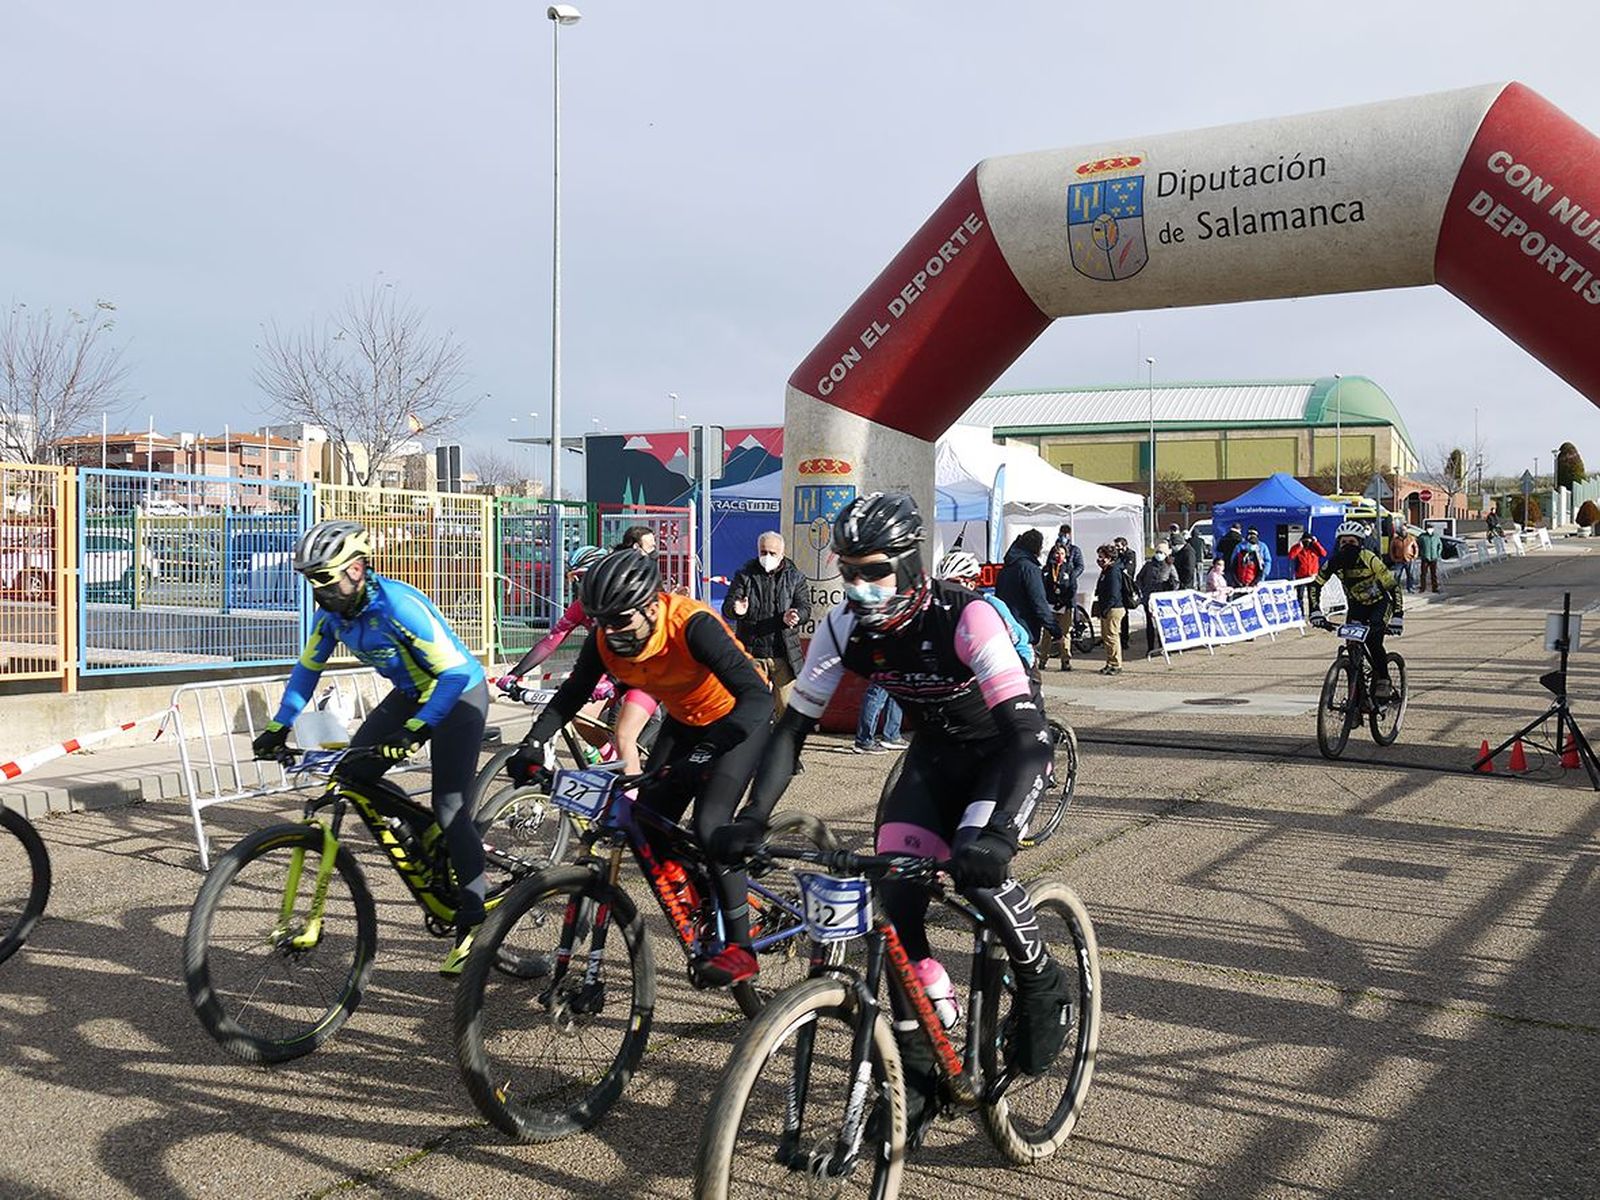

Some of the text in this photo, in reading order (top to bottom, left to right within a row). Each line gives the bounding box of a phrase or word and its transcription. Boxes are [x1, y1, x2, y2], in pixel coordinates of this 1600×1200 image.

[1157, 152, 1327, 200] Diputación
[1486, 150, 1554, 205] CON
[1158, 200, 1366, 245] de Salamanca
[817, 212, 984, 396] CON EL DEPORTE
[563, 780, 590, 801] 27
